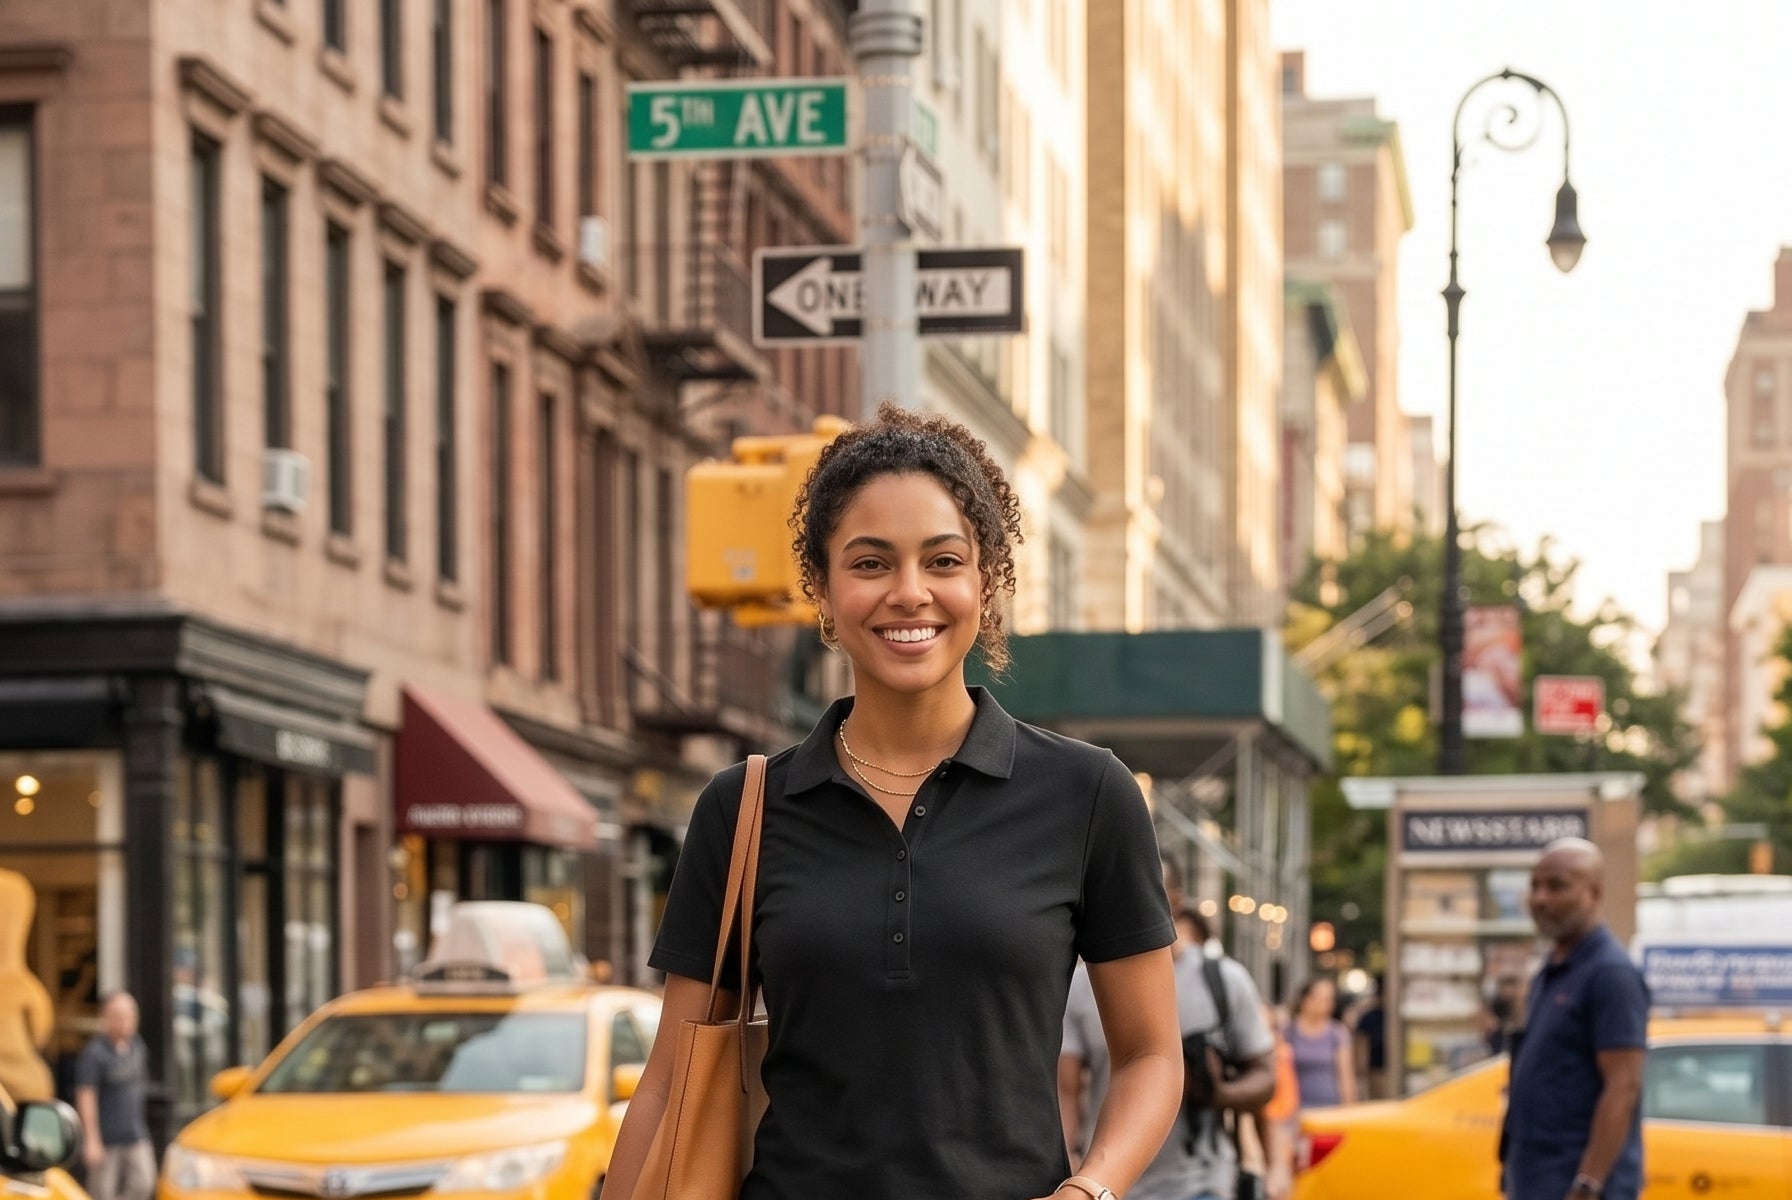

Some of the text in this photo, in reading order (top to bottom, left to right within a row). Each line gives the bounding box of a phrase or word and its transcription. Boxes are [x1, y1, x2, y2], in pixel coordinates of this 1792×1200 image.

[650, 90, 827, 148] 5TH AVE
[916, 271, 991, 308] WAY
